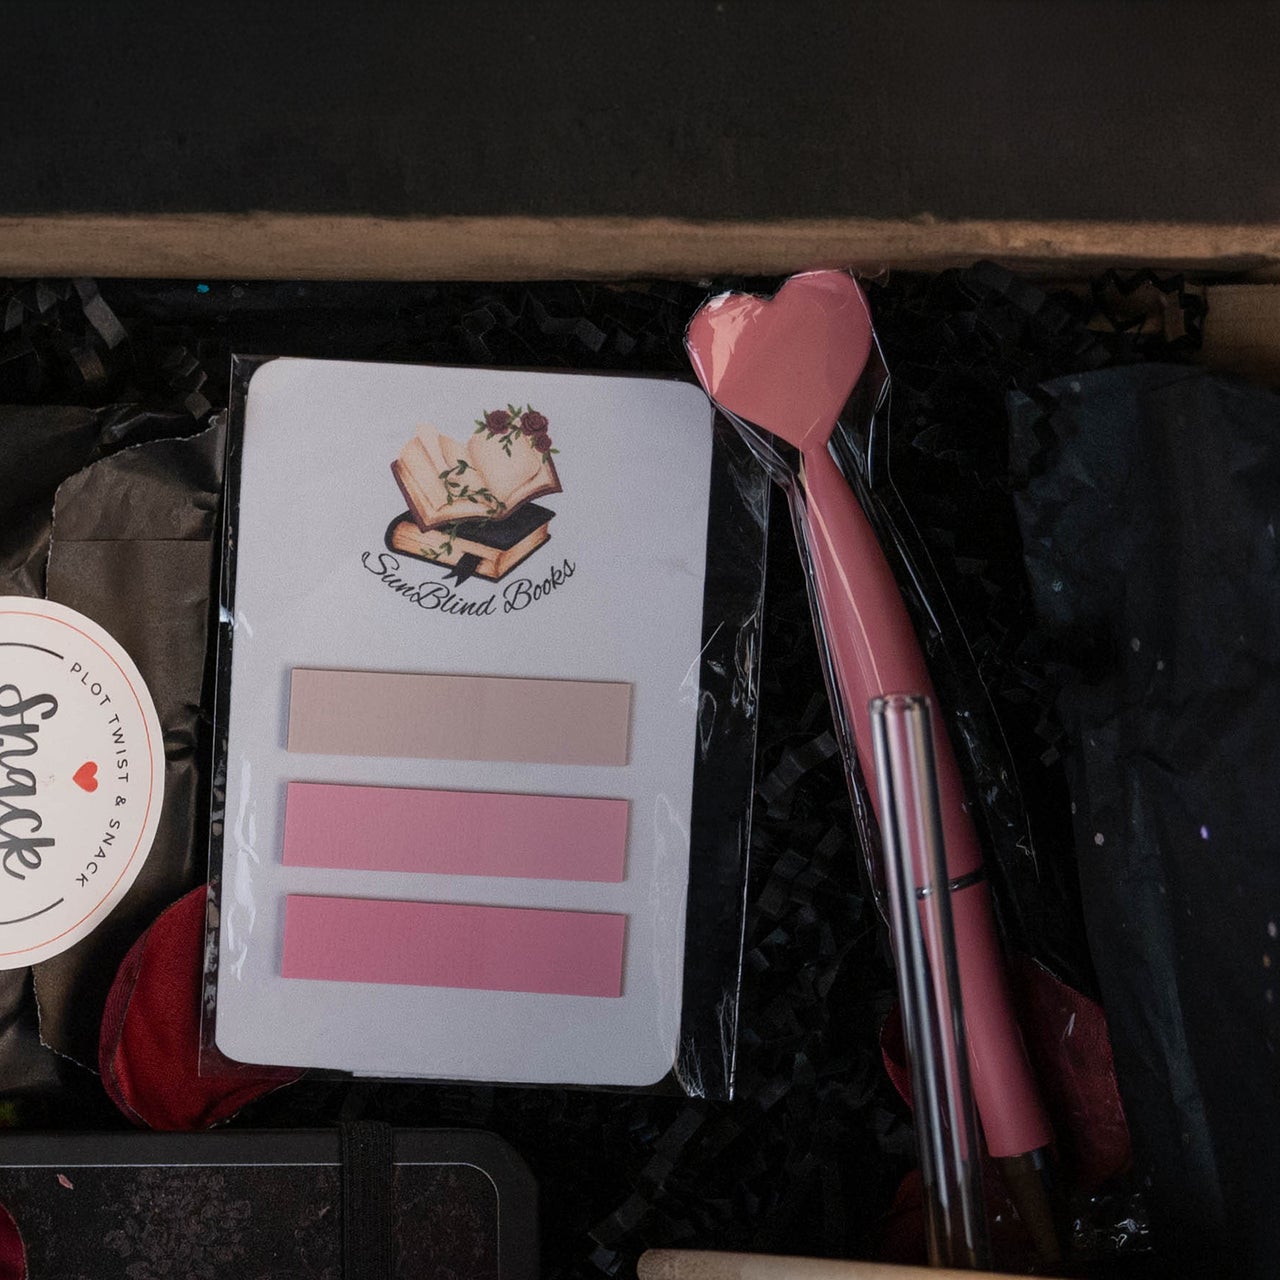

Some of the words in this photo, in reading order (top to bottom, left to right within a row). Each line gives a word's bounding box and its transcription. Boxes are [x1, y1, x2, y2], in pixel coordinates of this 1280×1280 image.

[503, 558, 577, 614] Books
[71, 662, 111, 706] PLOT
[108, 713, 129, 783] TWIST
[115, 795, 127, 807] &
[75, 819, 121, 888] SNACK
